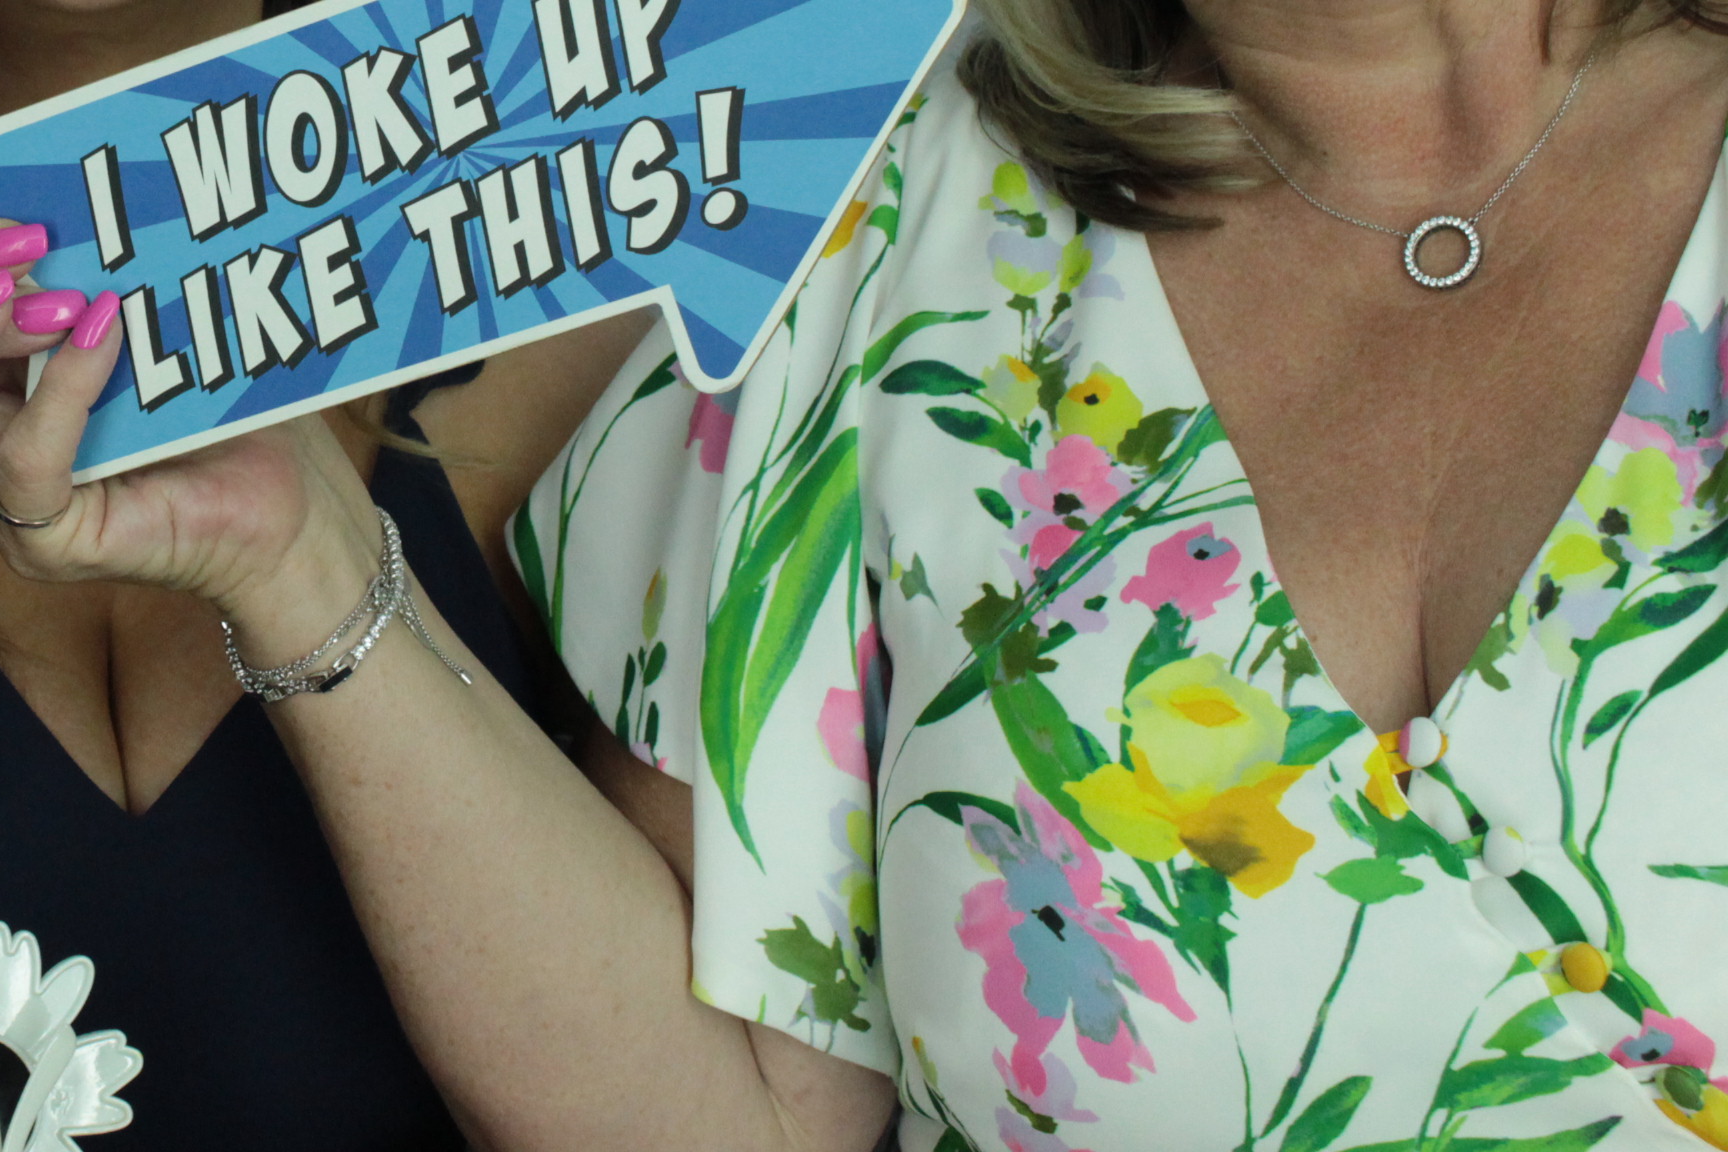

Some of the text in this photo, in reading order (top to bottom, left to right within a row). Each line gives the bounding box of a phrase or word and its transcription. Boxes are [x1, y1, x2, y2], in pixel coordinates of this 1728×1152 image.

[80, 144, 134, 272] I
[162, 13, 499, 242] WOKE
[118, 86, 746, 412] LIKE THIS!
